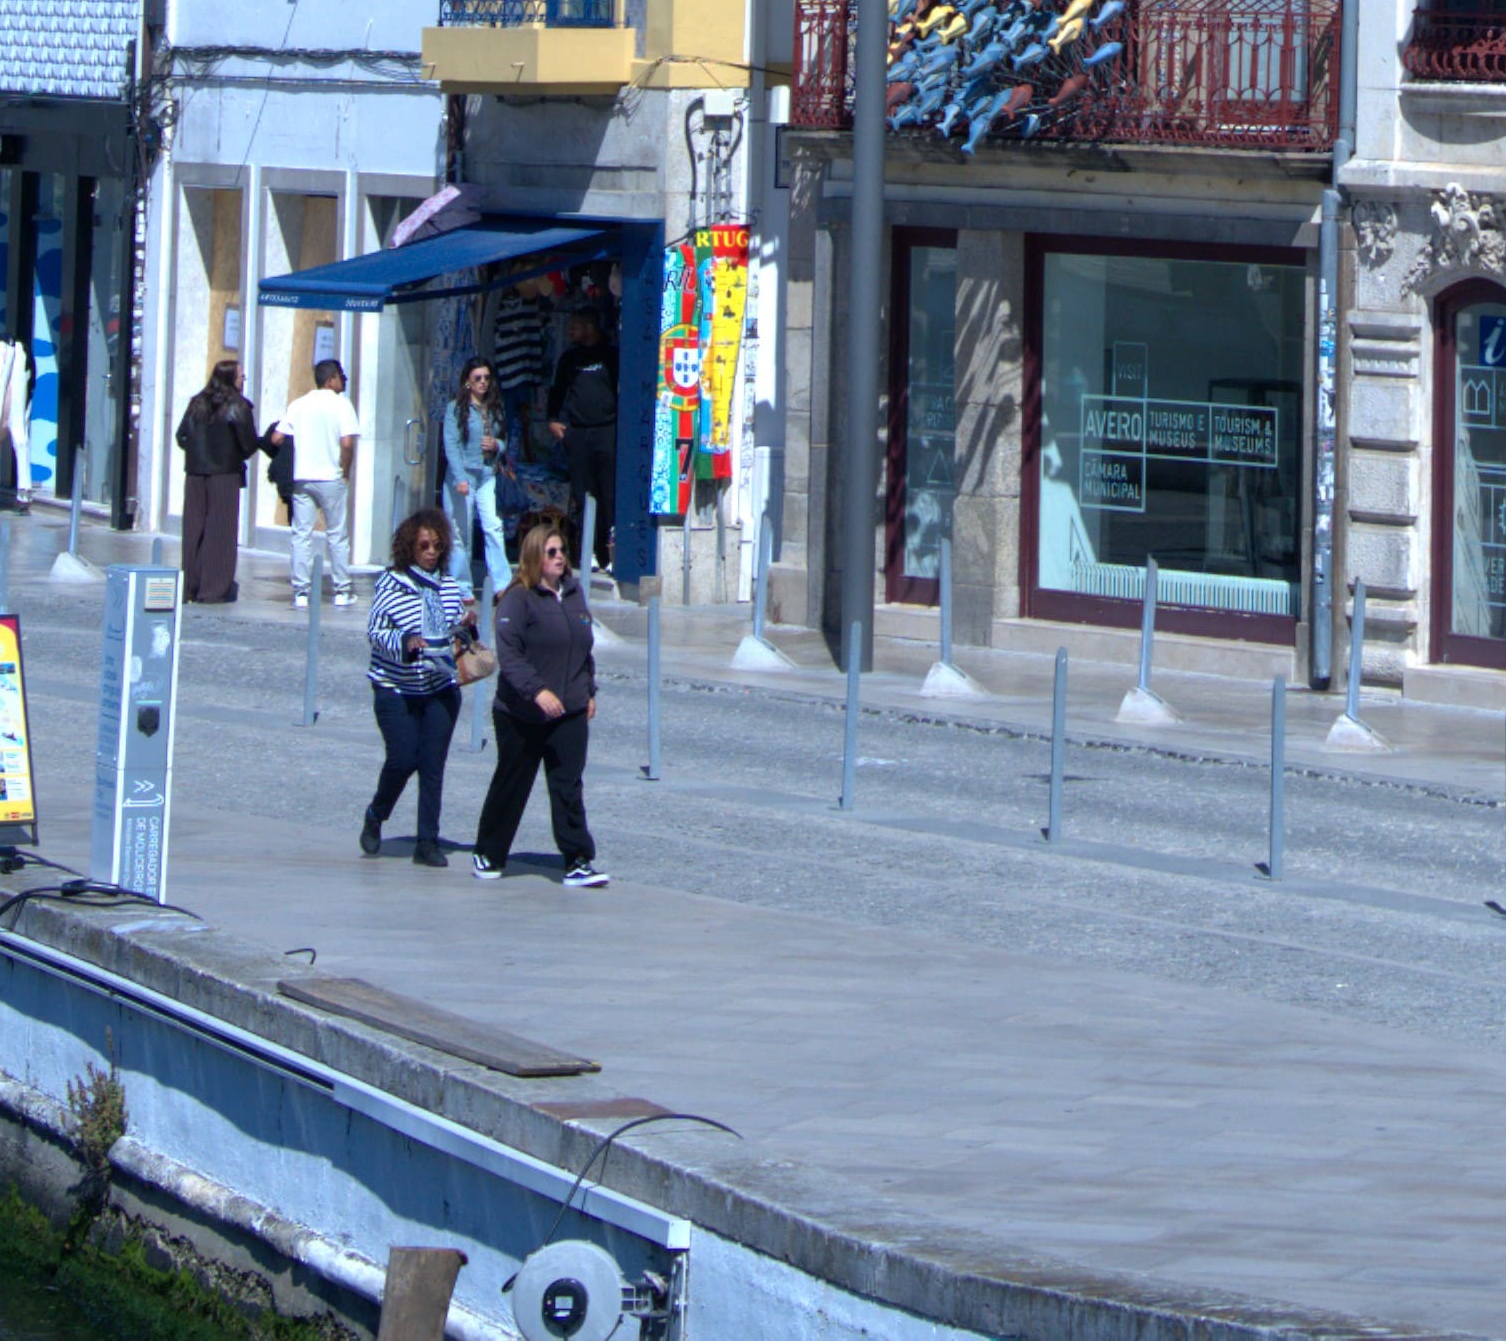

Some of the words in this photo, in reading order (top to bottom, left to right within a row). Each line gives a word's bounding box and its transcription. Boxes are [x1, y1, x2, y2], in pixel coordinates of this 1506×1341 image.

[1149, 410, 1195, 430] TURISMO
[1197, 414, 1205, 432] E
[1214, 415, 1260, 435] TOURISM
[1149, 430, 1196, 449] MUSEUS
[1214, 435, 1272, 455] MUSEUMS
[1085, 481, 1141, 500] MUNICIPAL
